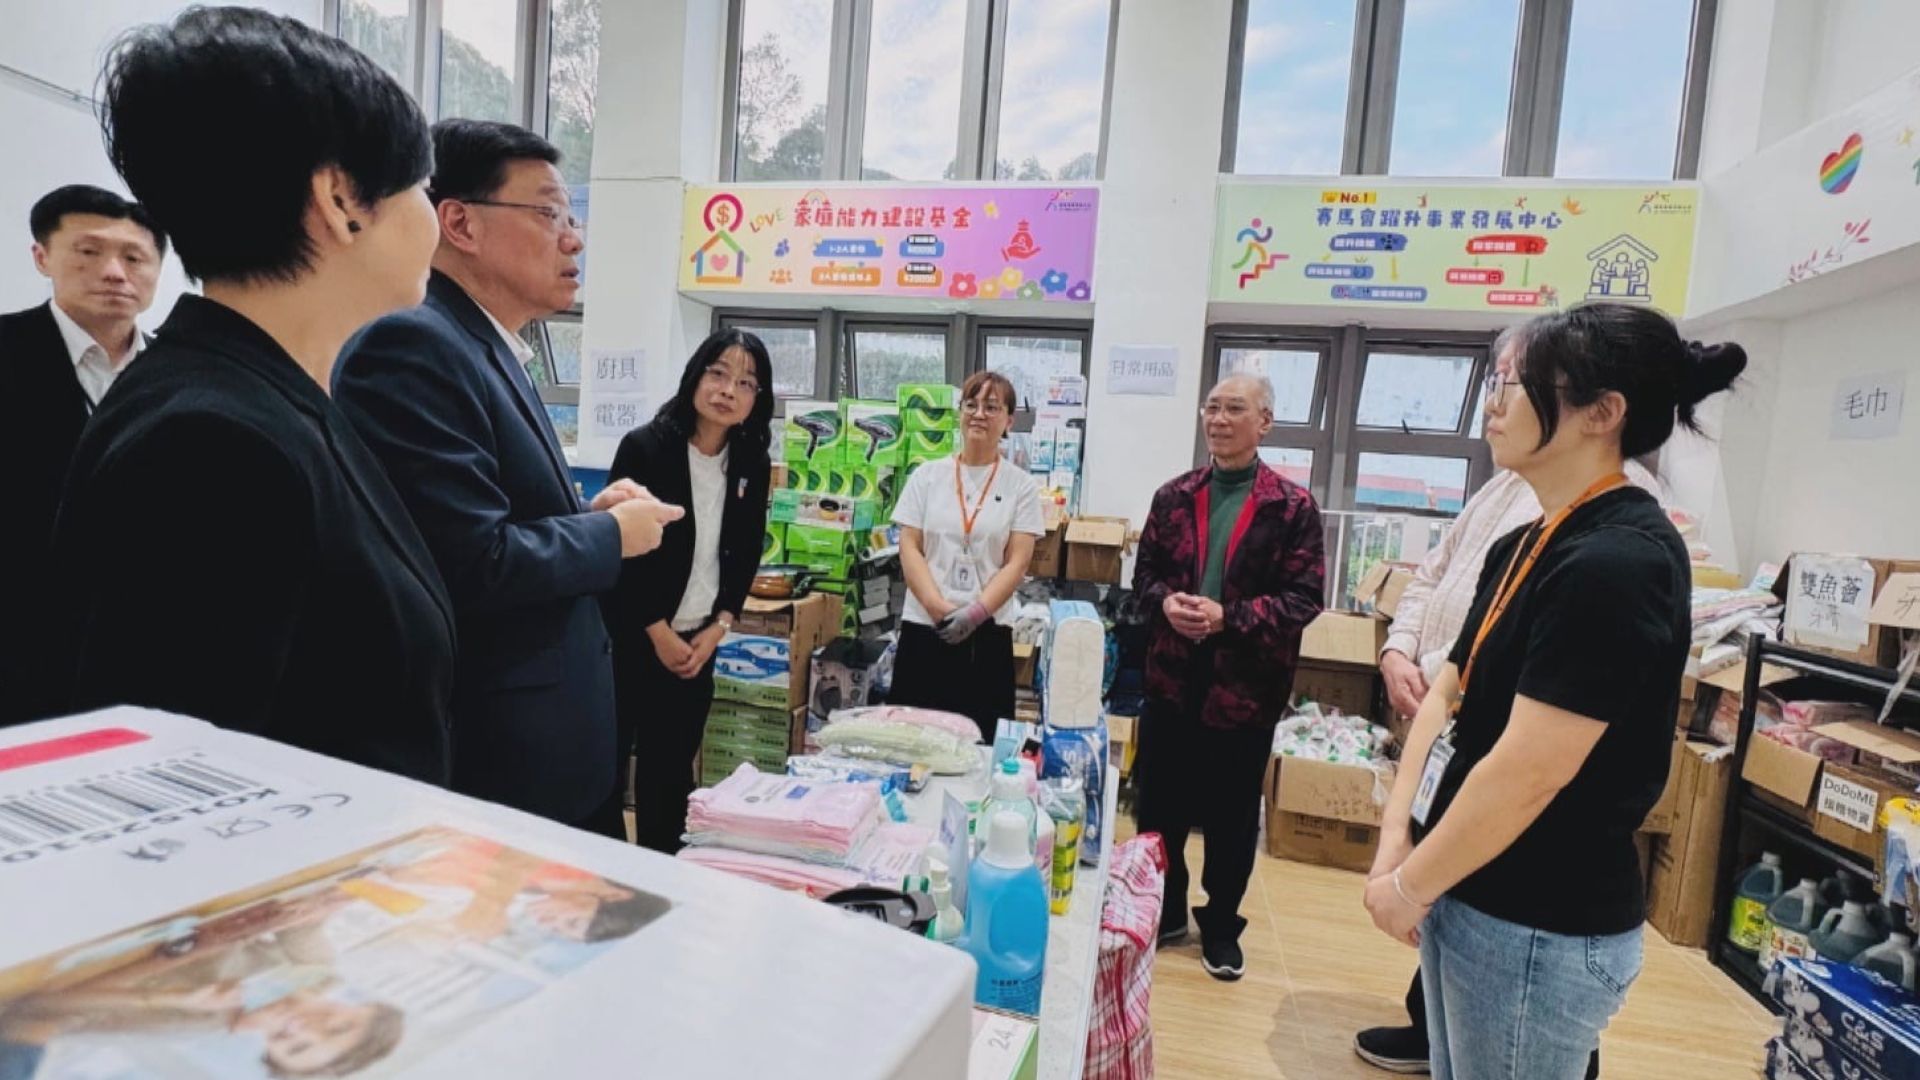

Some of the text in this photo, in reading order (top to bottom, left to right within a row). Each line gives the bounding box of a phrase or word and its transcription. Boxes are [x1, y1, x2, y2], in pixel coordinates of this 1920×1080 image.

[1339, 192, 1369, 204] No.1
[749, 208, 785, 233] LOVE
[794, 199, 971, 227] 家庭能力建設基金
[597, 357, 639, 380] 廚具
[1110, 359, 1175, 378] 日常用品
[594, 402, 637, 427] 電器
[1842, 387, 1889, 419] 毛巾
[1824, 778, 1875, 807] DoDoME
